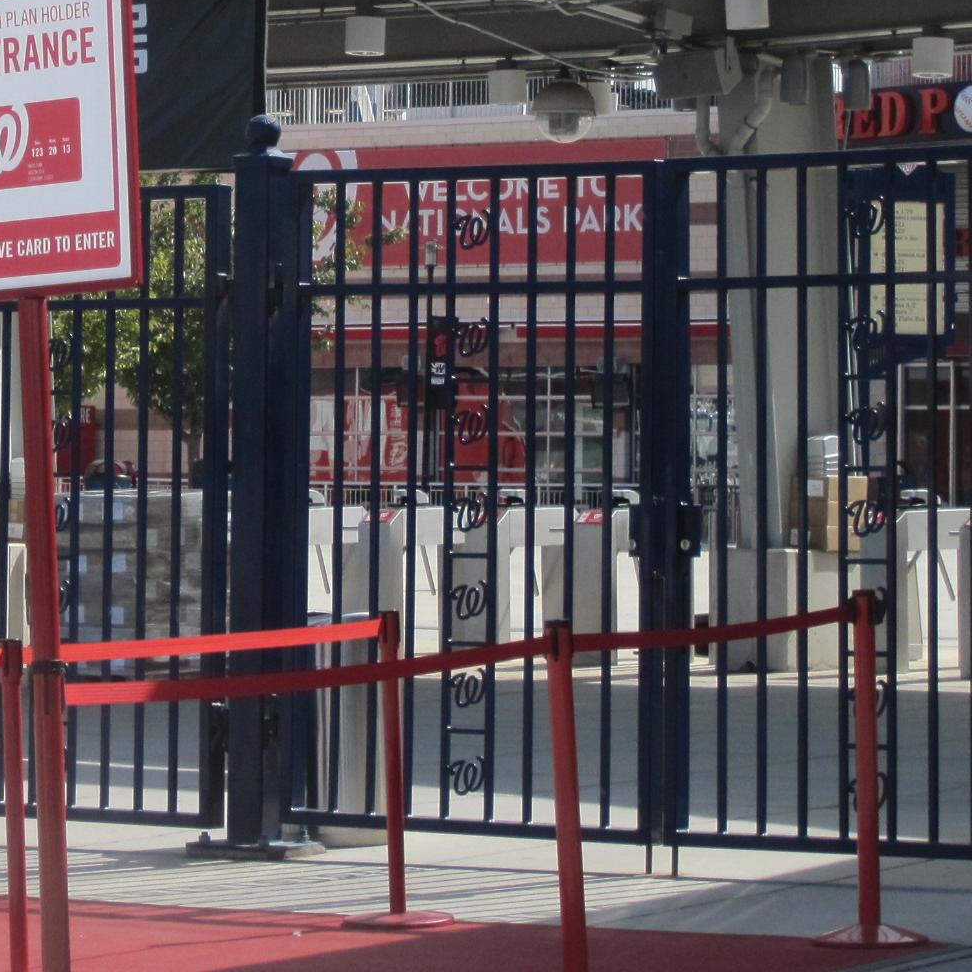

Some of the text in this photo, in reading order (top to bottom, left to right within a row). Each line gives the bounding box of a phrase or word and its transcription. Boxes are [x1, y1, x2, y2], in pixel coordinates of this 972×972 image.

[6, 8, 38, 28] PLAN
[41, 1, 90, 23] HOLDER
[31, 143, 71, 158] 123 20 13
[563, 203, 644, 234] PARK
[17, 237, 51, 256] CARD
[55, 235, 71, 253] TO
[75, 230, 116, 251] ENTER
